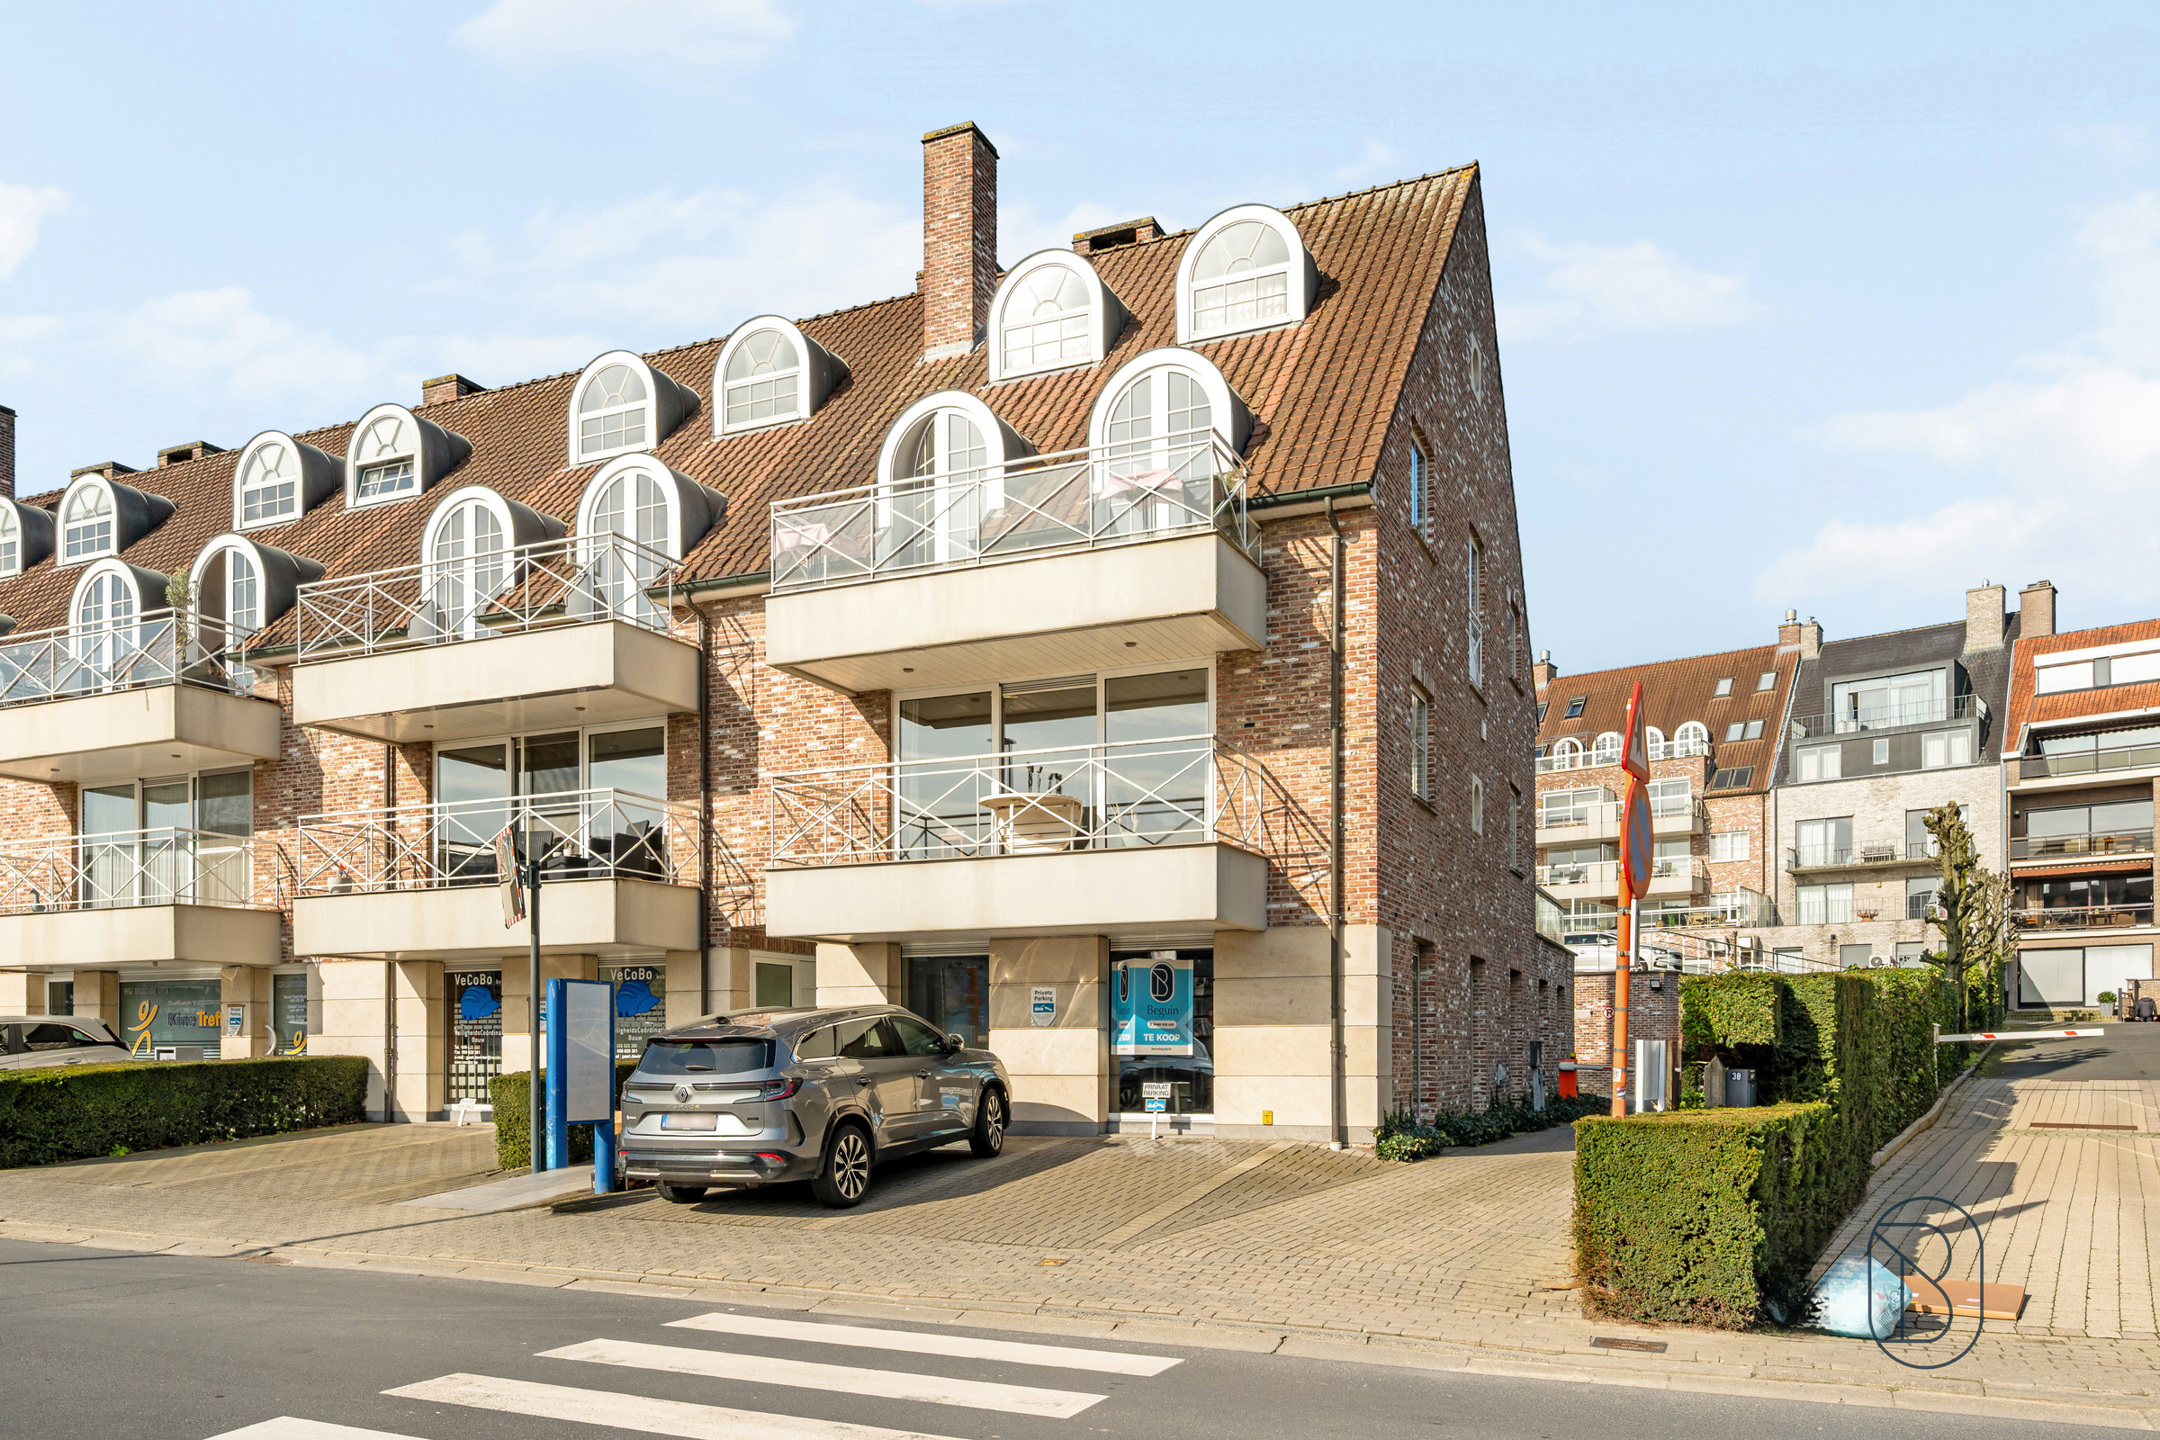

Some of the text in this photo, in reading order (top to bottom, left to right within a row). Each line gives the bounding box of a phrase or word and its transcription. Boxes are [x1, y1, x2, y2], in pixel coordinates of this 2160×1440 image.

[454, 973, 493, 986] VeCoBo
[610, 968, 653, 981] VeCoBo
[1147, 1005, 1179, 1018] Beguin
[167, 1011, 221, 1027] Kine Tref
[1143, 1033, 1181, 1042] TE KOOP
[1731, 1072, 1742, 1081] 38
